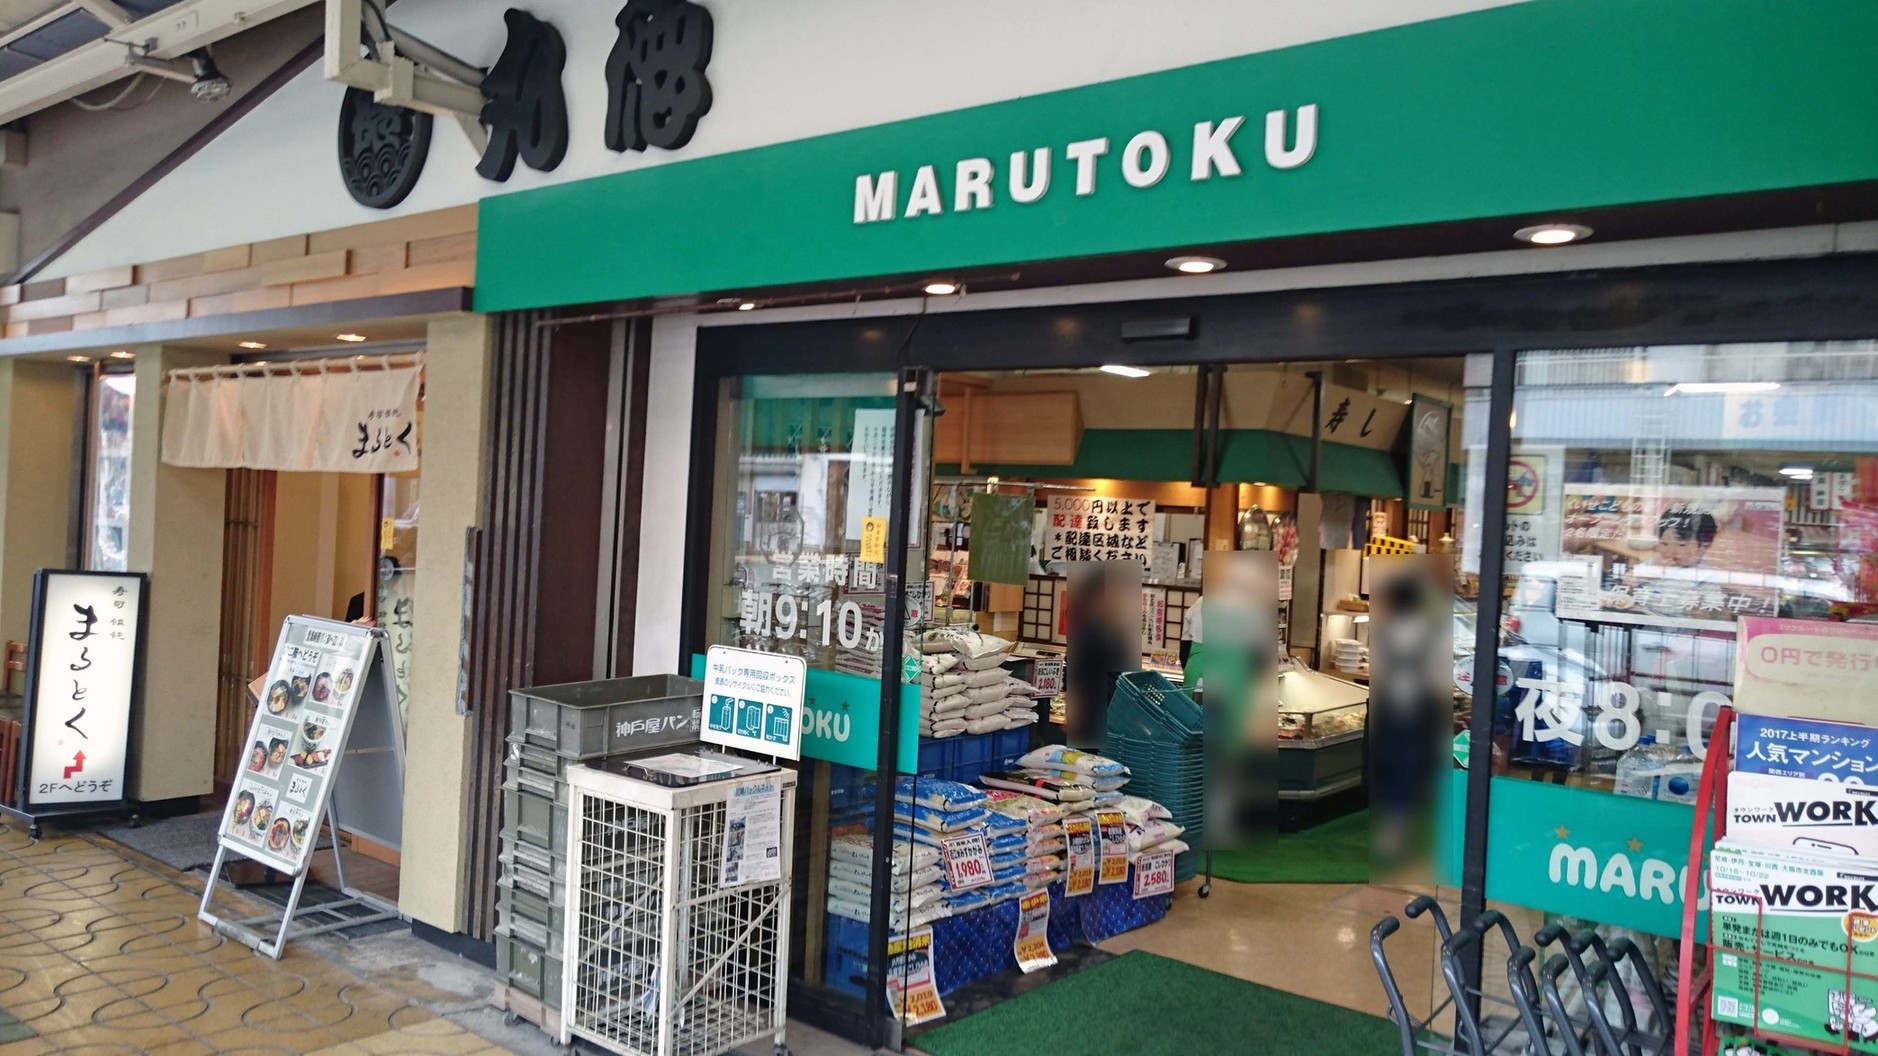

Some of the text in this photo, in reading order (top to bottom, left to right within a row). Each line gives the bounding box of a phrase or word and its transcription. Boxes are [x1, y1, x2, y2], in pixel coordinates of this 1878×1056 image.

[854, 104, 1317, 223] MARUTOKU
[1053, 514, 1149, 532] 配達致します
[772, 550, 878, 590] 営業時間
[64, 603, 99, 740] まるとく
[1761, 646, 1878, 672] 0円で発行
[615, 714, 690, 738] 神戸屋パン
[1760, 728, 1871, 748] 2017上半期ランキング
[39, 779, 113, 794] 2Fへどうぞ
[1733, 800, 1878, 826] TOWN WORK
[1760, 884, 1878, 912] WORK
